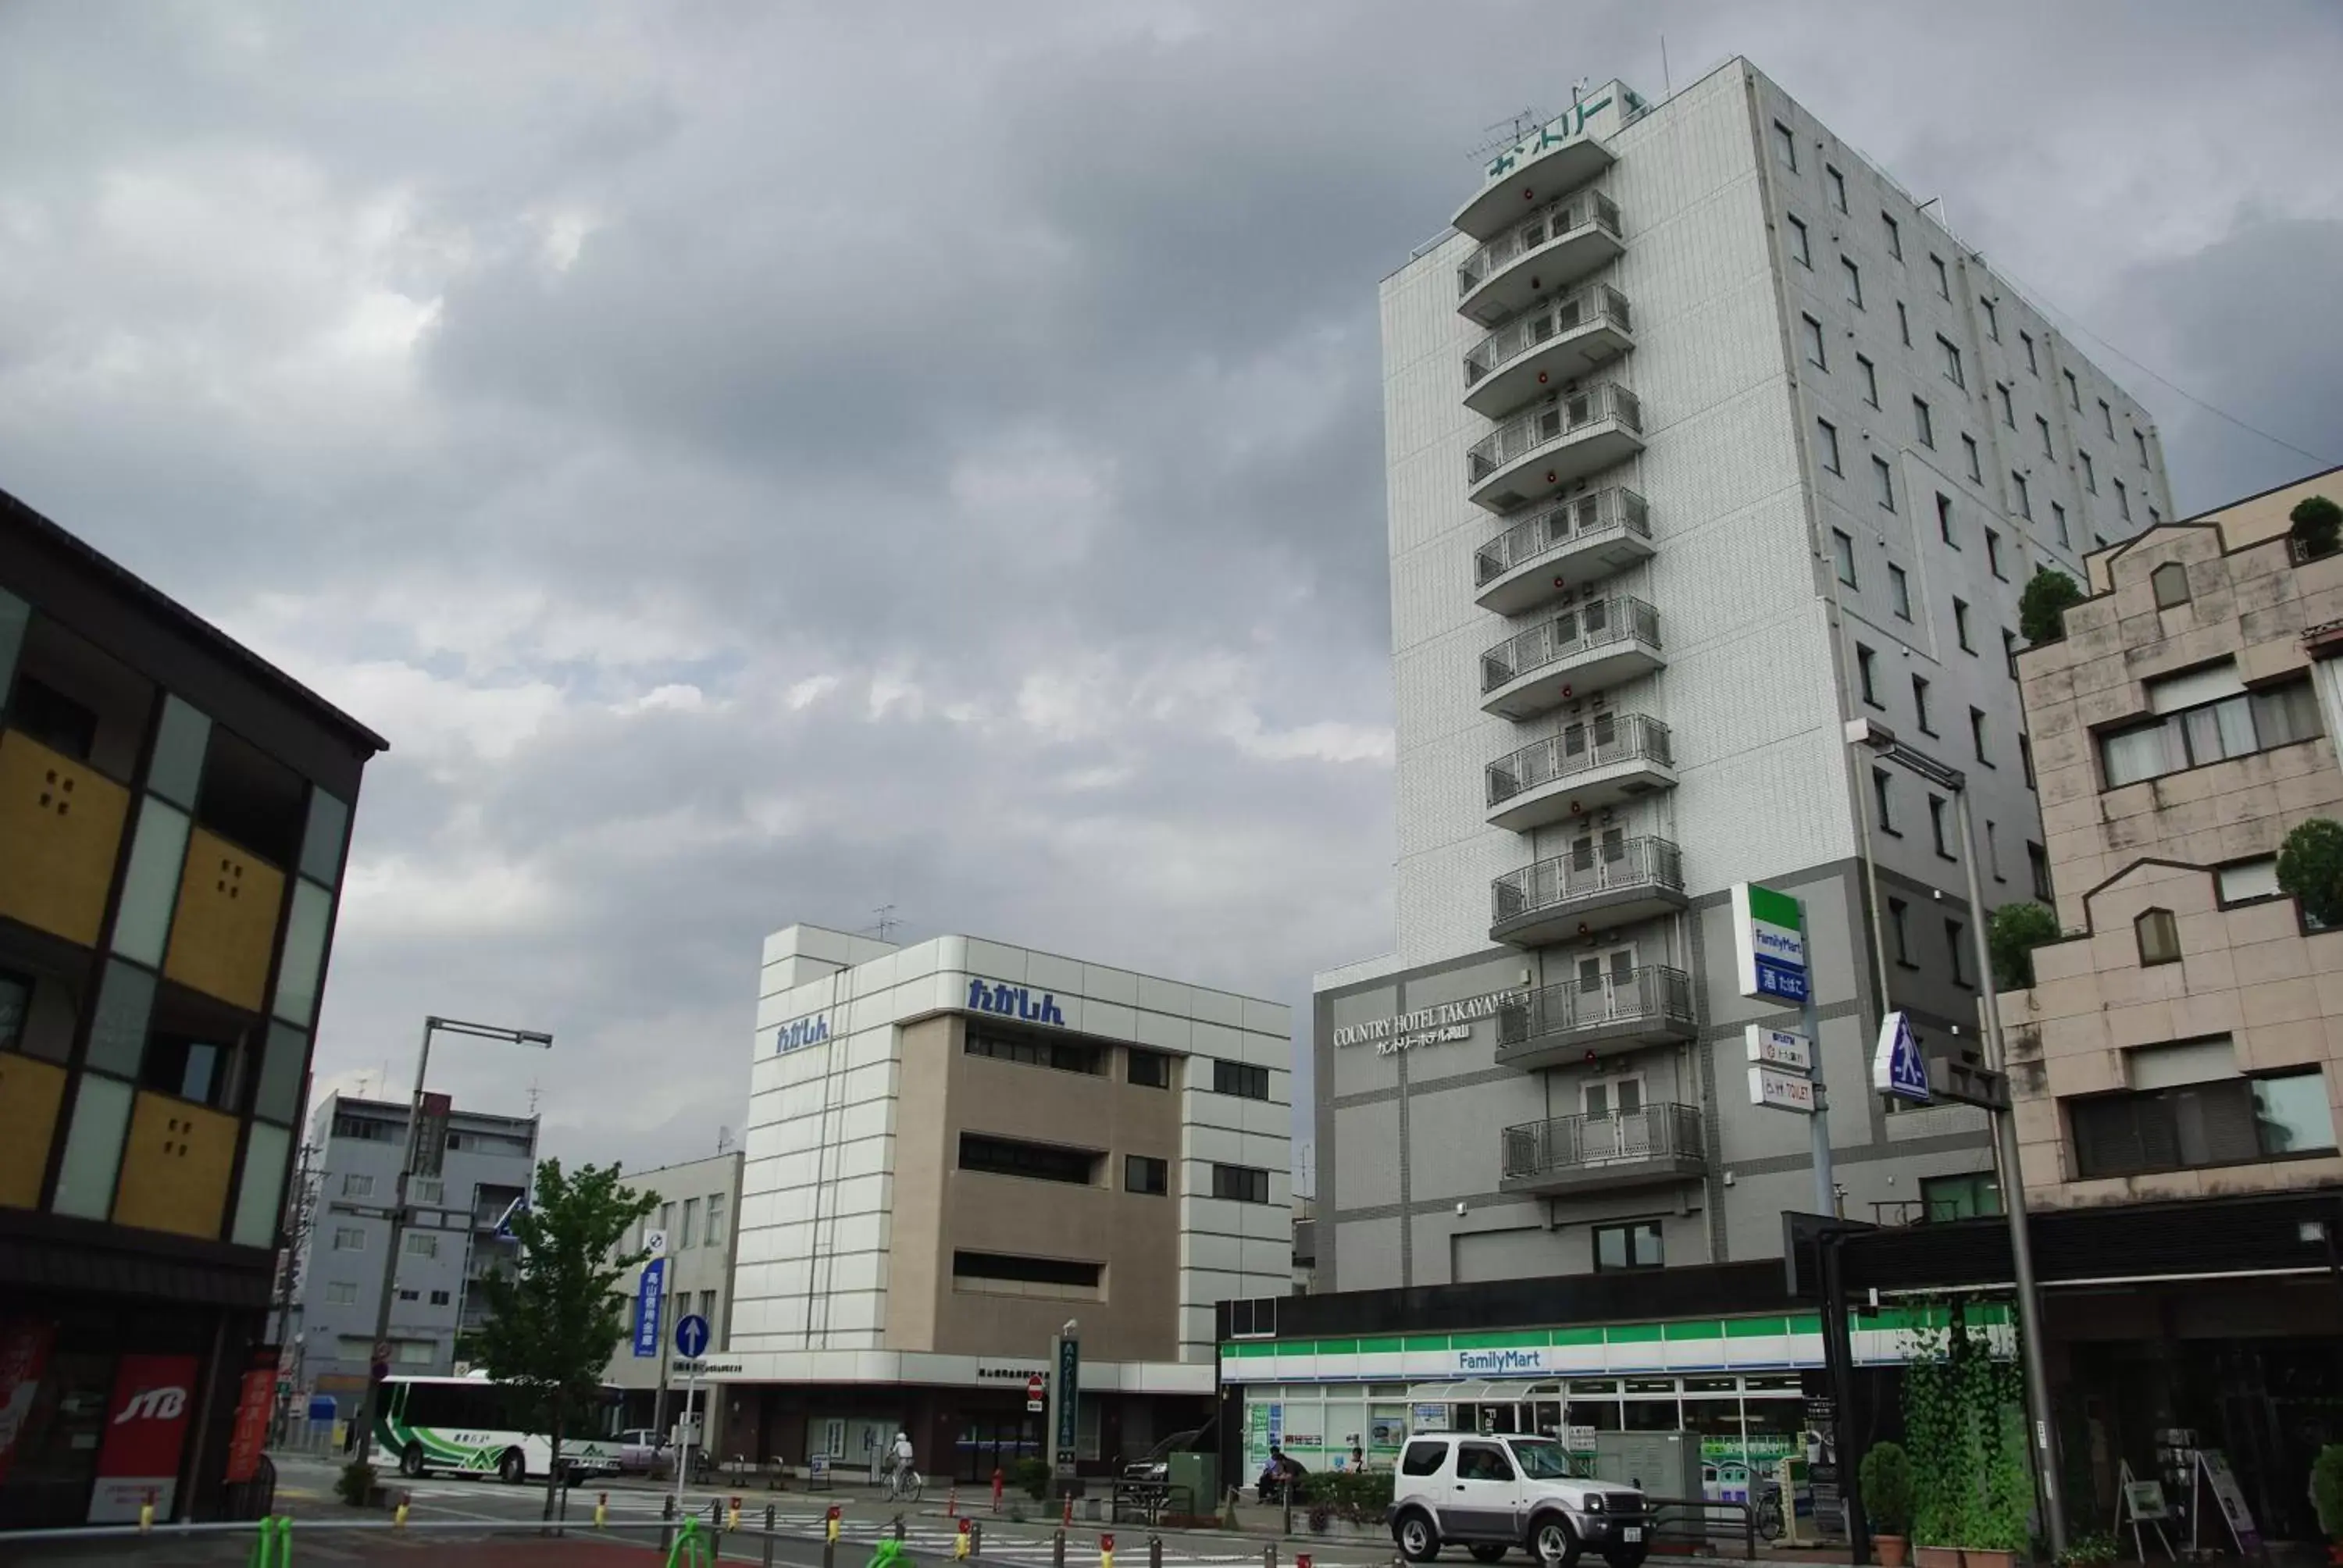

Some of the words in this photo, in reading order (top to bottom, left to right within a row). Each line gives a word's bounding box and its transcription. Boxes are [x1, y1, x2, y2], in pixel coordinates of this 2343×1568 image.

[1489, 96, 1612, 177] カントリー
[1756, 930, 1802, 953] FamilyMart
[1779, 975, 1804, 996] たばこ
[1333, 1017, 1392, 1047] COUNTRY
[1394, 1007, 1437, 1034] HOTEL
[1459, 1350, 1541, 1374] FamilyMart
[113, 1386, 188, 1425] JTB
